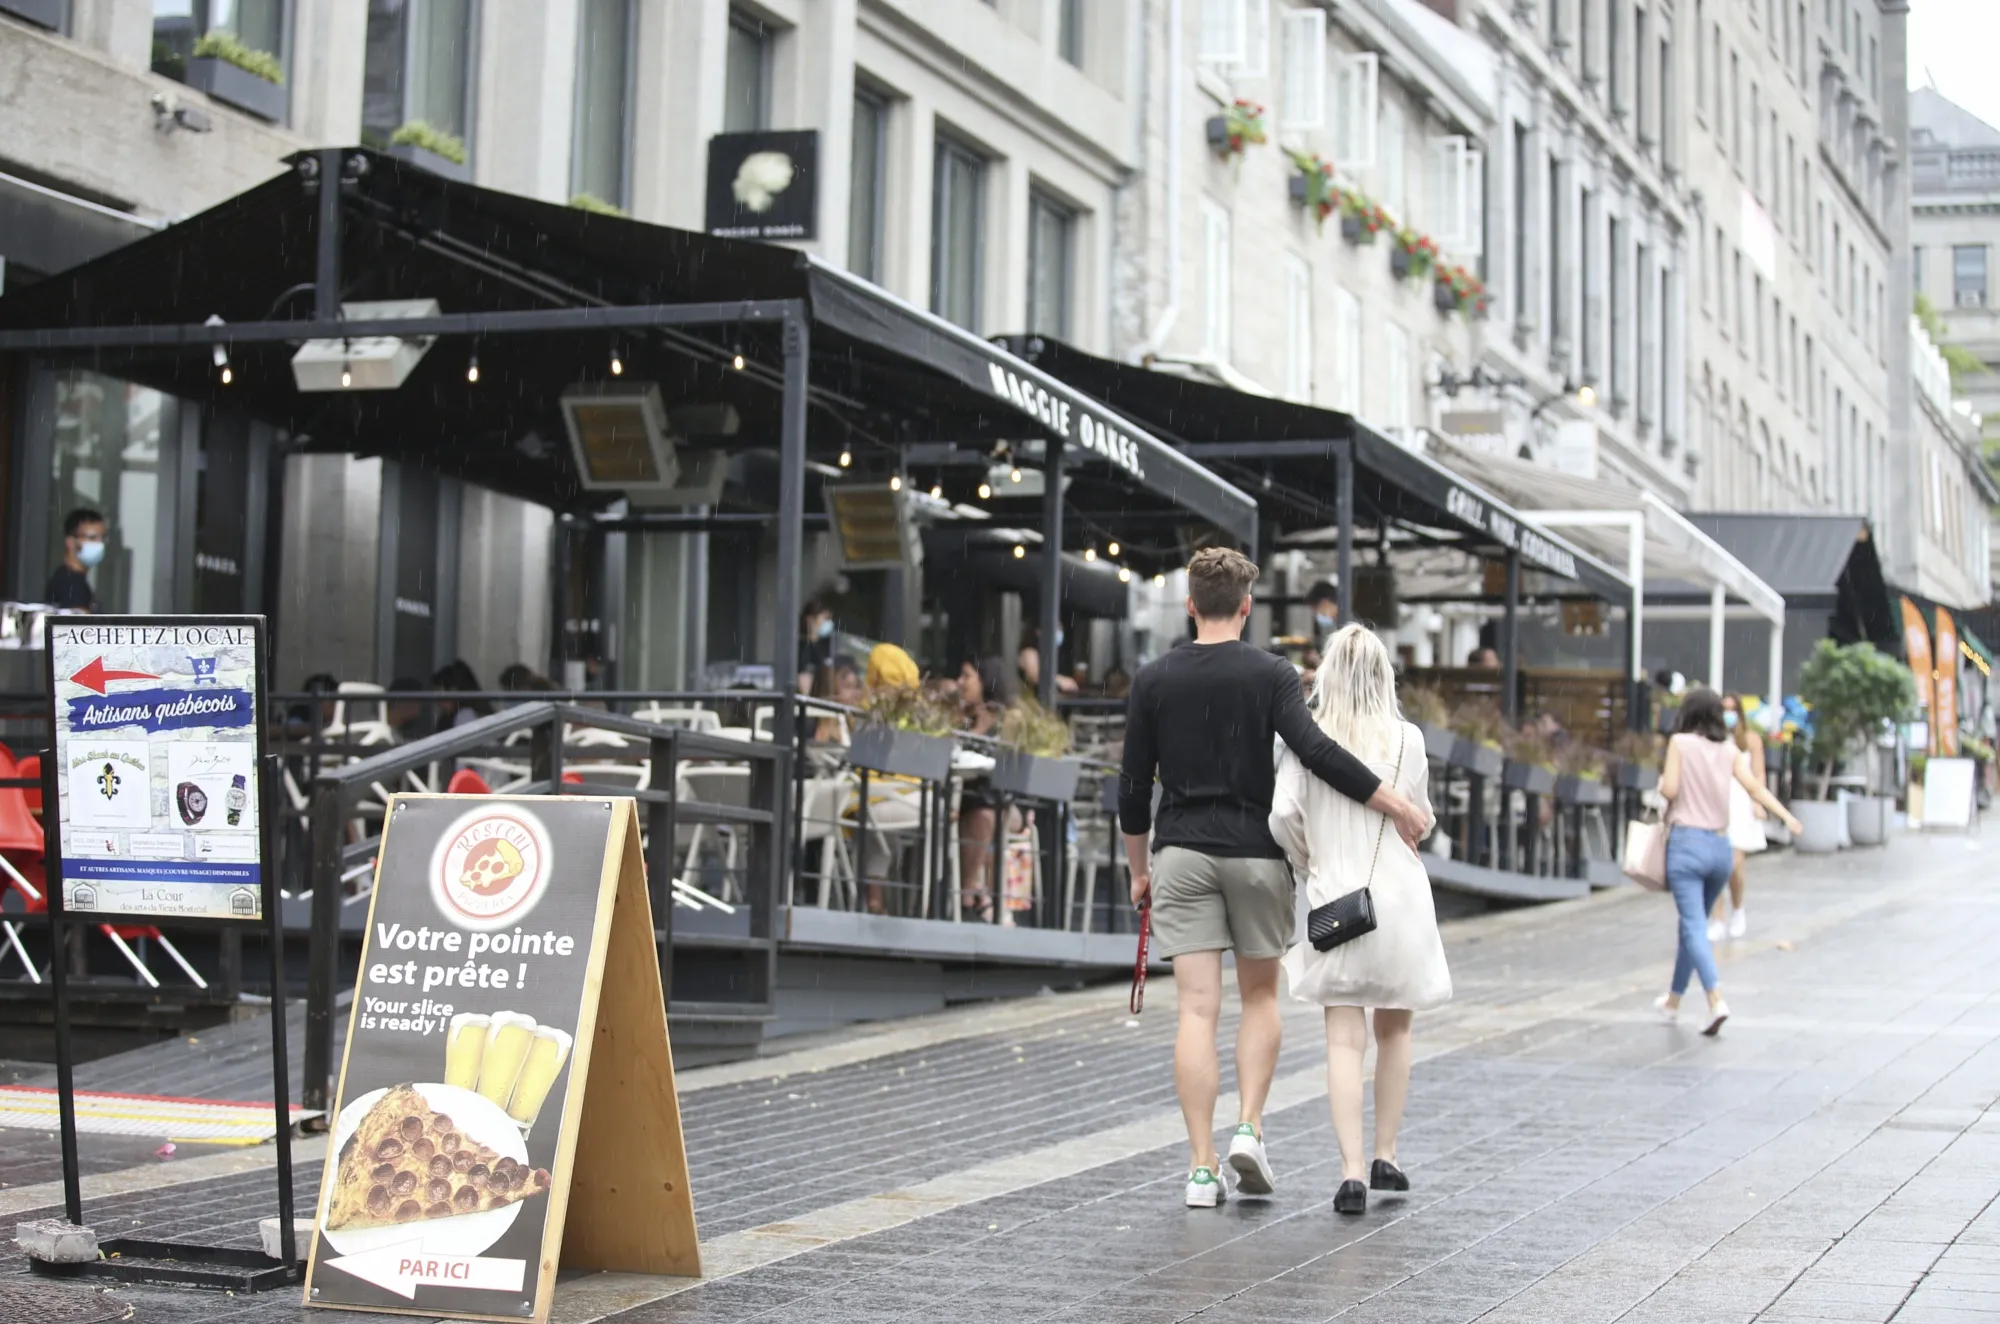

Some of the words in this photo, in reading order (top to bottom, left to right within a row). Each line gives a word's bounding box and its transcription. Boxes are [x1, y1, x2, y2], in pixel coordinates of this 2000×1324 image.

[66, 628, 167, 645] ACHETEZ
[173, 628, 248, 646] LOCAL
[83, 703, 152, 725] Artisans
[155, 692, 236, 725] québécois
[212, 869, 250, 877] DISPONIBLES
[142, 888, 154, 901] La
[156, 888, 184, 902] Cour
[377, 923, 462, 951] Votre
[468, 927, 575, 959] pointe
[369, 960, 417, 985] est
[422, 960, 509, 992] prête
[364, 996, 408, 1014] Your
[411, 999, 454, 1016] slice
[360, 1012, 376, 1029] is
[380, 1015, 436, 1036] ready
[399, 1259, 439, 1277] PAR
[444, 1262, 470, 1279] ICI
